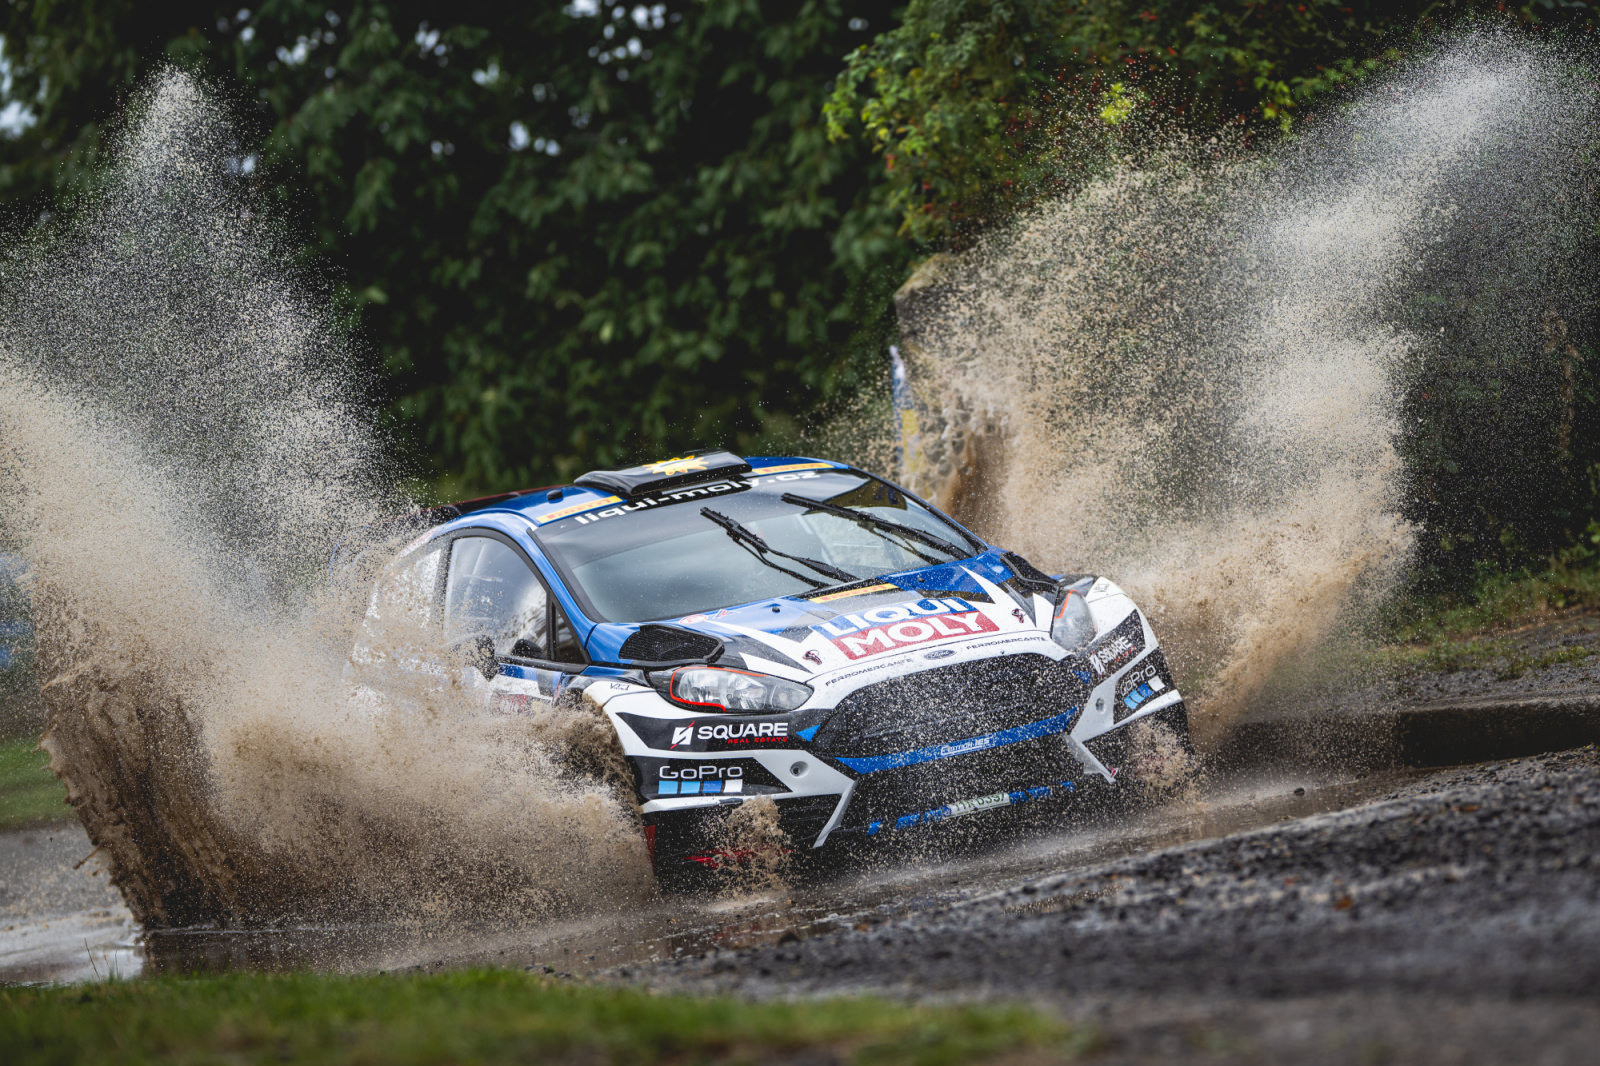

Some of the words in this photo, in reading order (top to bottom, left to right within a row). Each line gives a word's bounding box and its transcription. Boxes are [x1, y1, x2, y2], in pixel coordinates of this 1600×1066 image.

[574, 470, 821, 525] liqui-moly.cz
[820, 598, 971, 637] LIQUI
[840, 610, 988, 657] MOLY
[697, 722, 789, 740] SQUARE
[659, 765, 743, 779] GoPro
